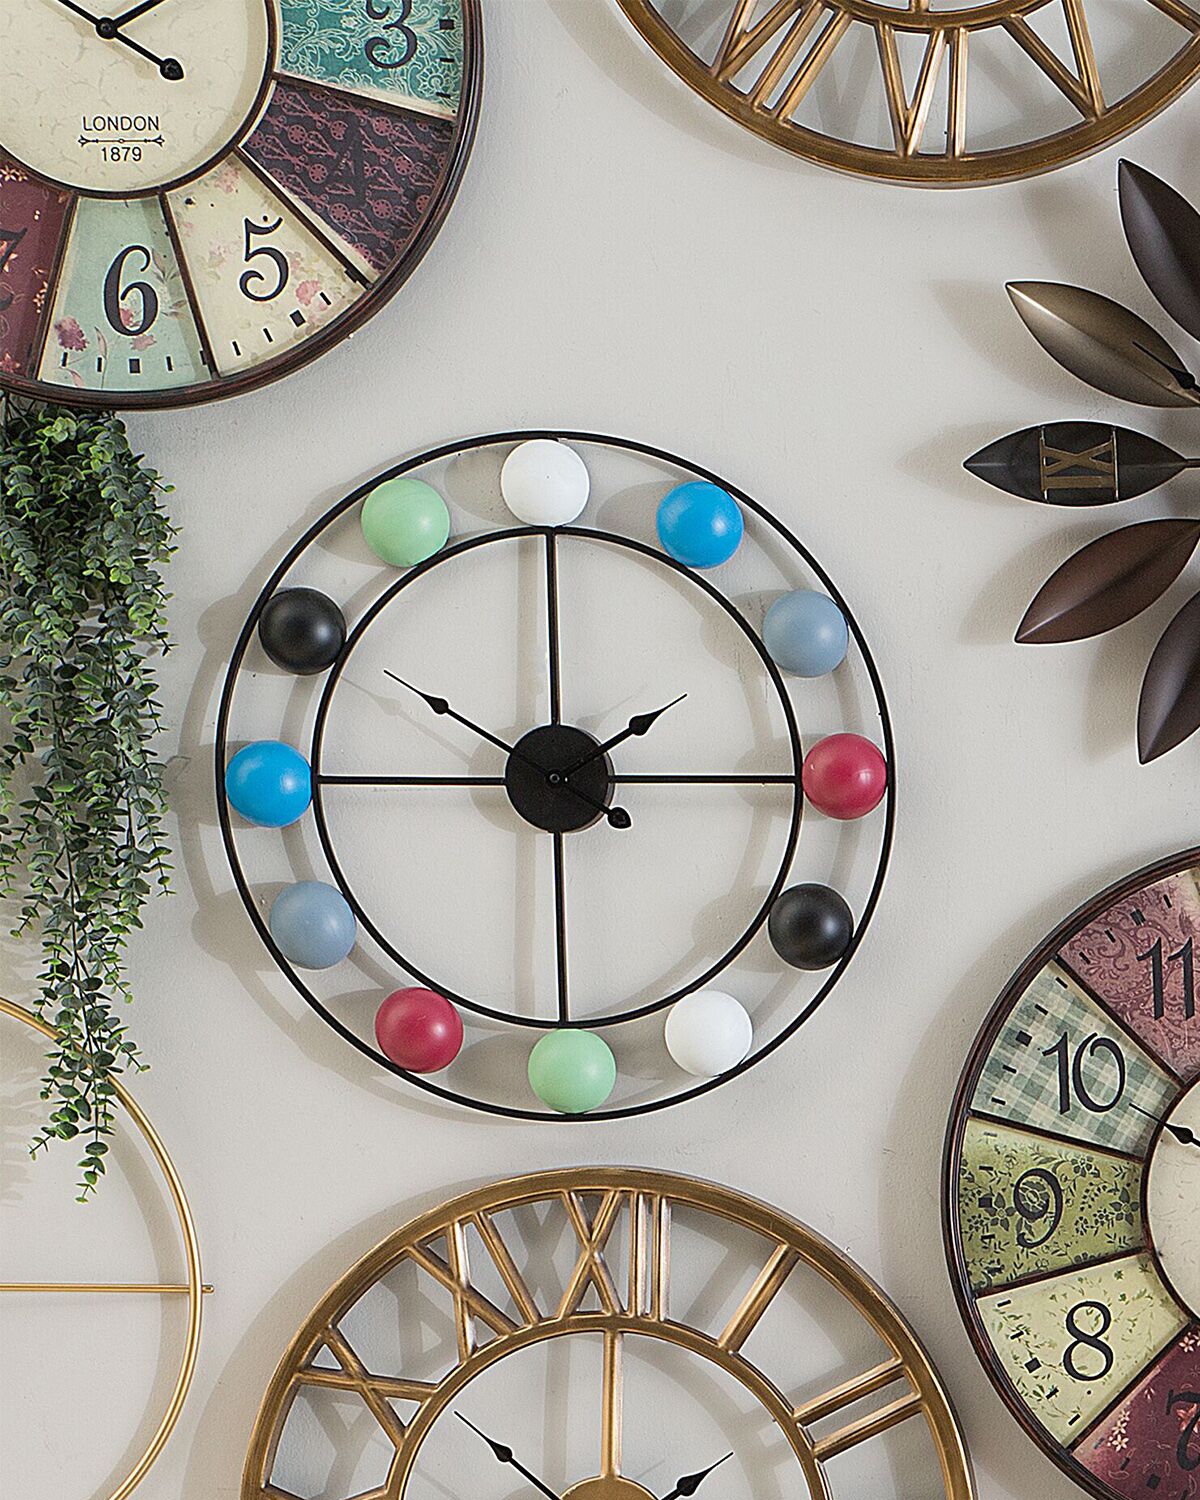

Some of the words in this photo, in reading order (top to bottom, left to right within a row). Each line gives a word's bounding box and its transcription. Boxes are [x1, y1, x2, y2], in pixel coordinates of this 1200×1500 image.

[364, 0, 417, 69] 3
[82, 116, 161, 132] LONDON
[100, 146, 142, 162] 1879
[103, 244, 159, 337] 6
[239, 215, 290, 302] 5
[1135, 936, 1200, 1022] 11
[1043, 1032, 1127, 1115] 10
[1013, 1167, 1065, 1248] 9
[404, 1212, 543, 1363] XI
[559, 1188, 672, 1322] XII
[1062, 1300, 1115, 1382] 8
[296, 1327, 440, 1450] X
